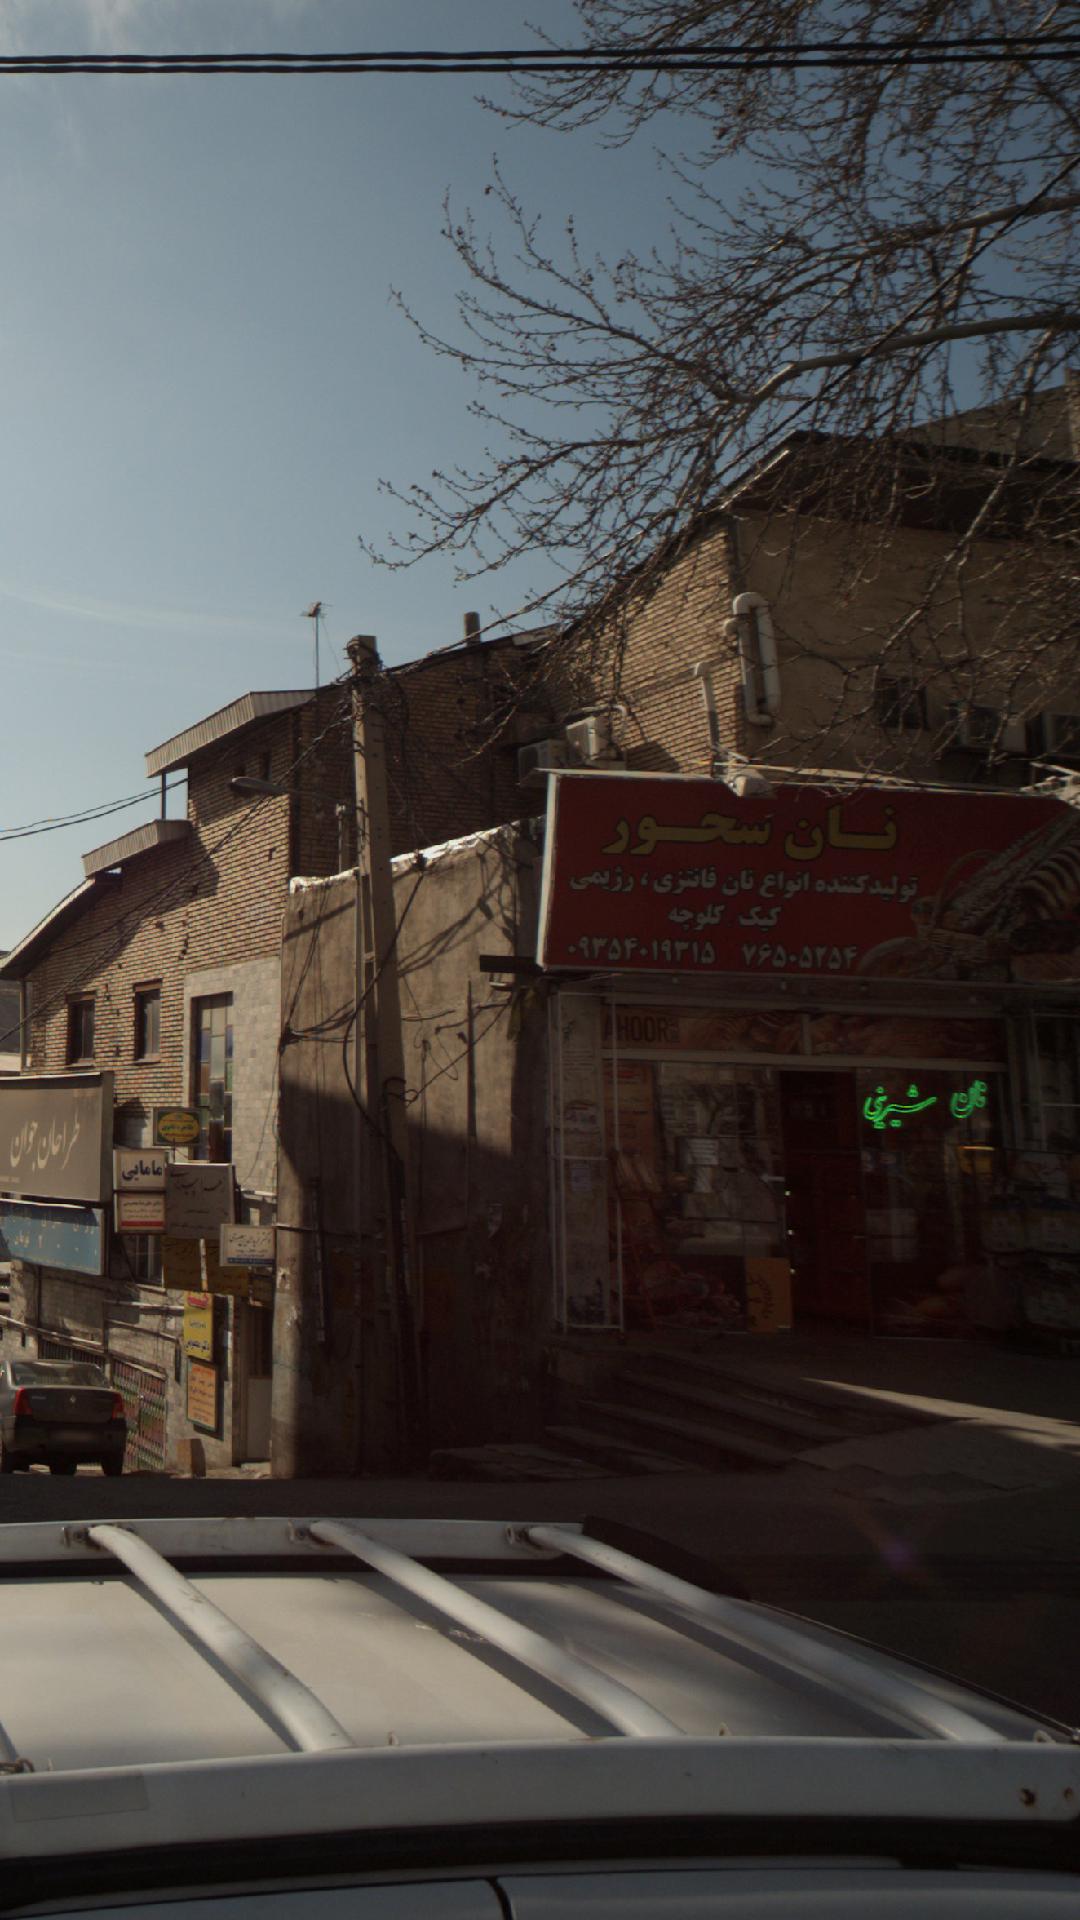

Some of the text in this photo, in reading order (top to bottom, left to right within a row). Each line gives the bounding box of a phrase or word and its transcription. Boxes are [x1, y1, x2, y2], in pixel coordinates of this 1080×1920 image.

[601, 804, 897, 861] نان سحور
[569, 865, 635, 892] رژیمی
[653, 865, 717, 894] فانتزی
[721, 867, 755, 896] نان
[759, 870, 811, 899] انواع
[668, 903, 782, 931] کیک کلوچه
[568, 935, 716, 964] ۰۹۳۵۴۰۱۹۳۱۵
[863, 1084, 937, 1129] شیرینی
[10, 1109, 80, 1172] طراحان جوان
[121, 1160, 163, 1181] مامایی
